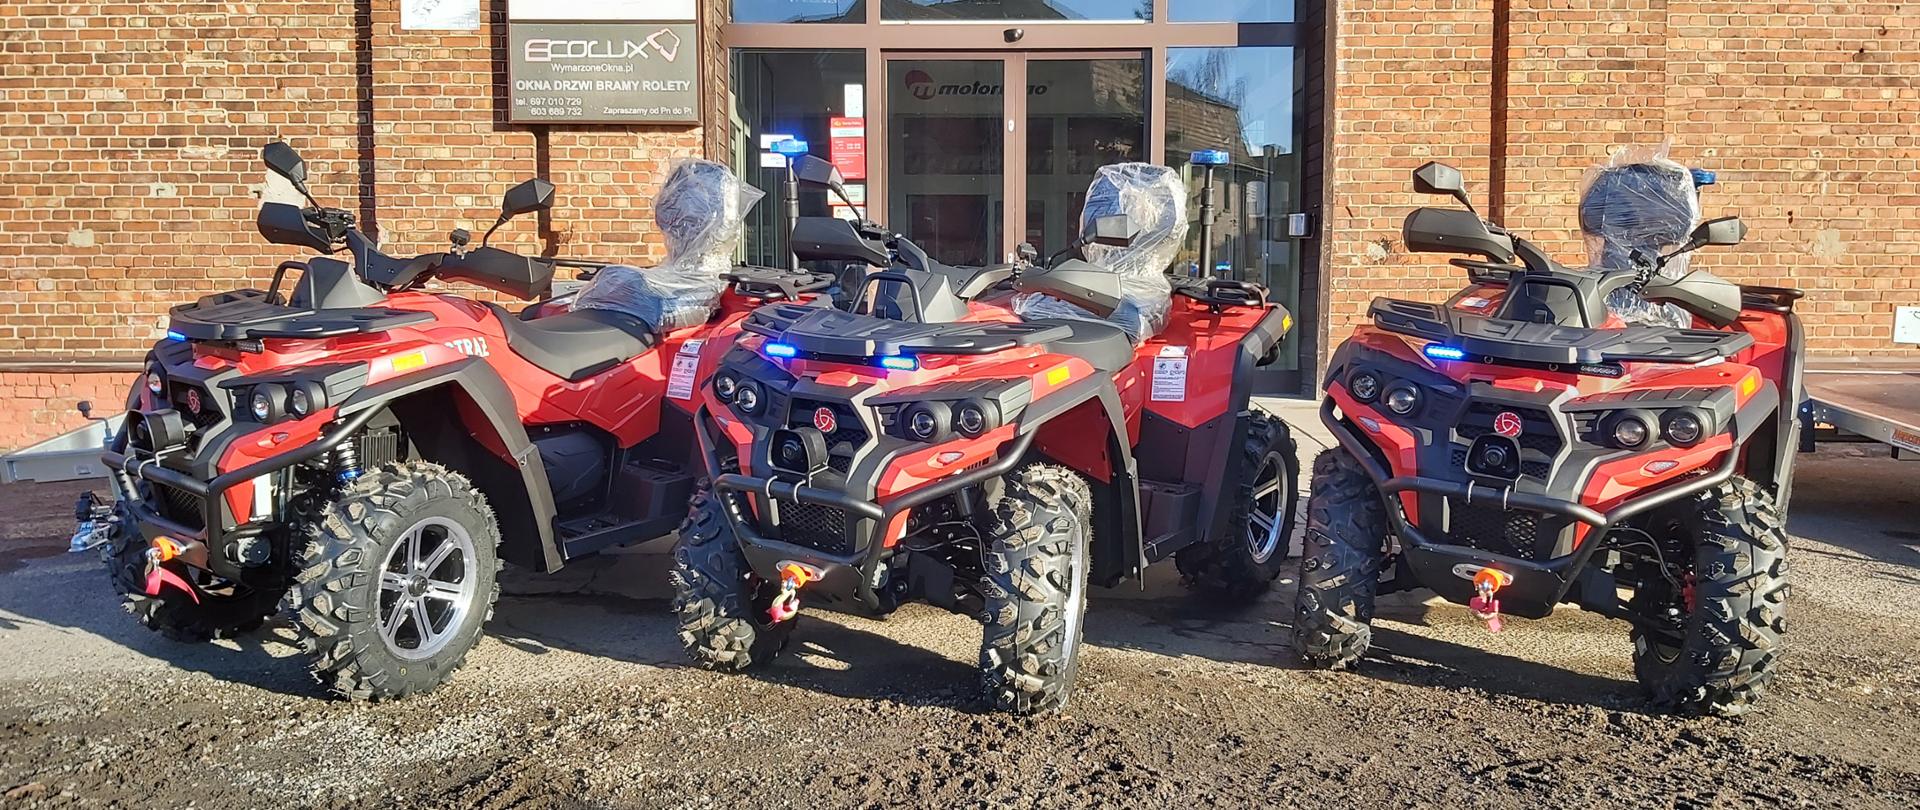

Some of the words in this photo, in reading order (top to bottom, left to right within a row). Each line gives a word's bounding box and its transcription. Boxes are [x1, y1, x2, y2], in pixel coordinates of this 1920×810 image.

[524, 39, 649, 62] ECOLUX
[551, 63, 634, 74] WymarzoneOkna.pl
[516, 80, 552, 91] OKNA
[554, 80, 593, 91] DRZWI
[596, 80, 640, 91] BRAMY
[642, 80, 691, 91] ROLETY
[515, 98, 528, 106] tel.
[530, 97, 546, 106] 697
[548, 97, 564, 106] 010
[566, 97, 582, 106] 729
[531, 107, 547, 116] 603
[548, 107, 565, 116] 689
[567, 107, 583, 116] 732
[603, 107, 648, 116] Zapraszamy
[649, 107, 659, 115] od
[661, 107, 671, 115] Pn
[672, 107, 682, 115] do
